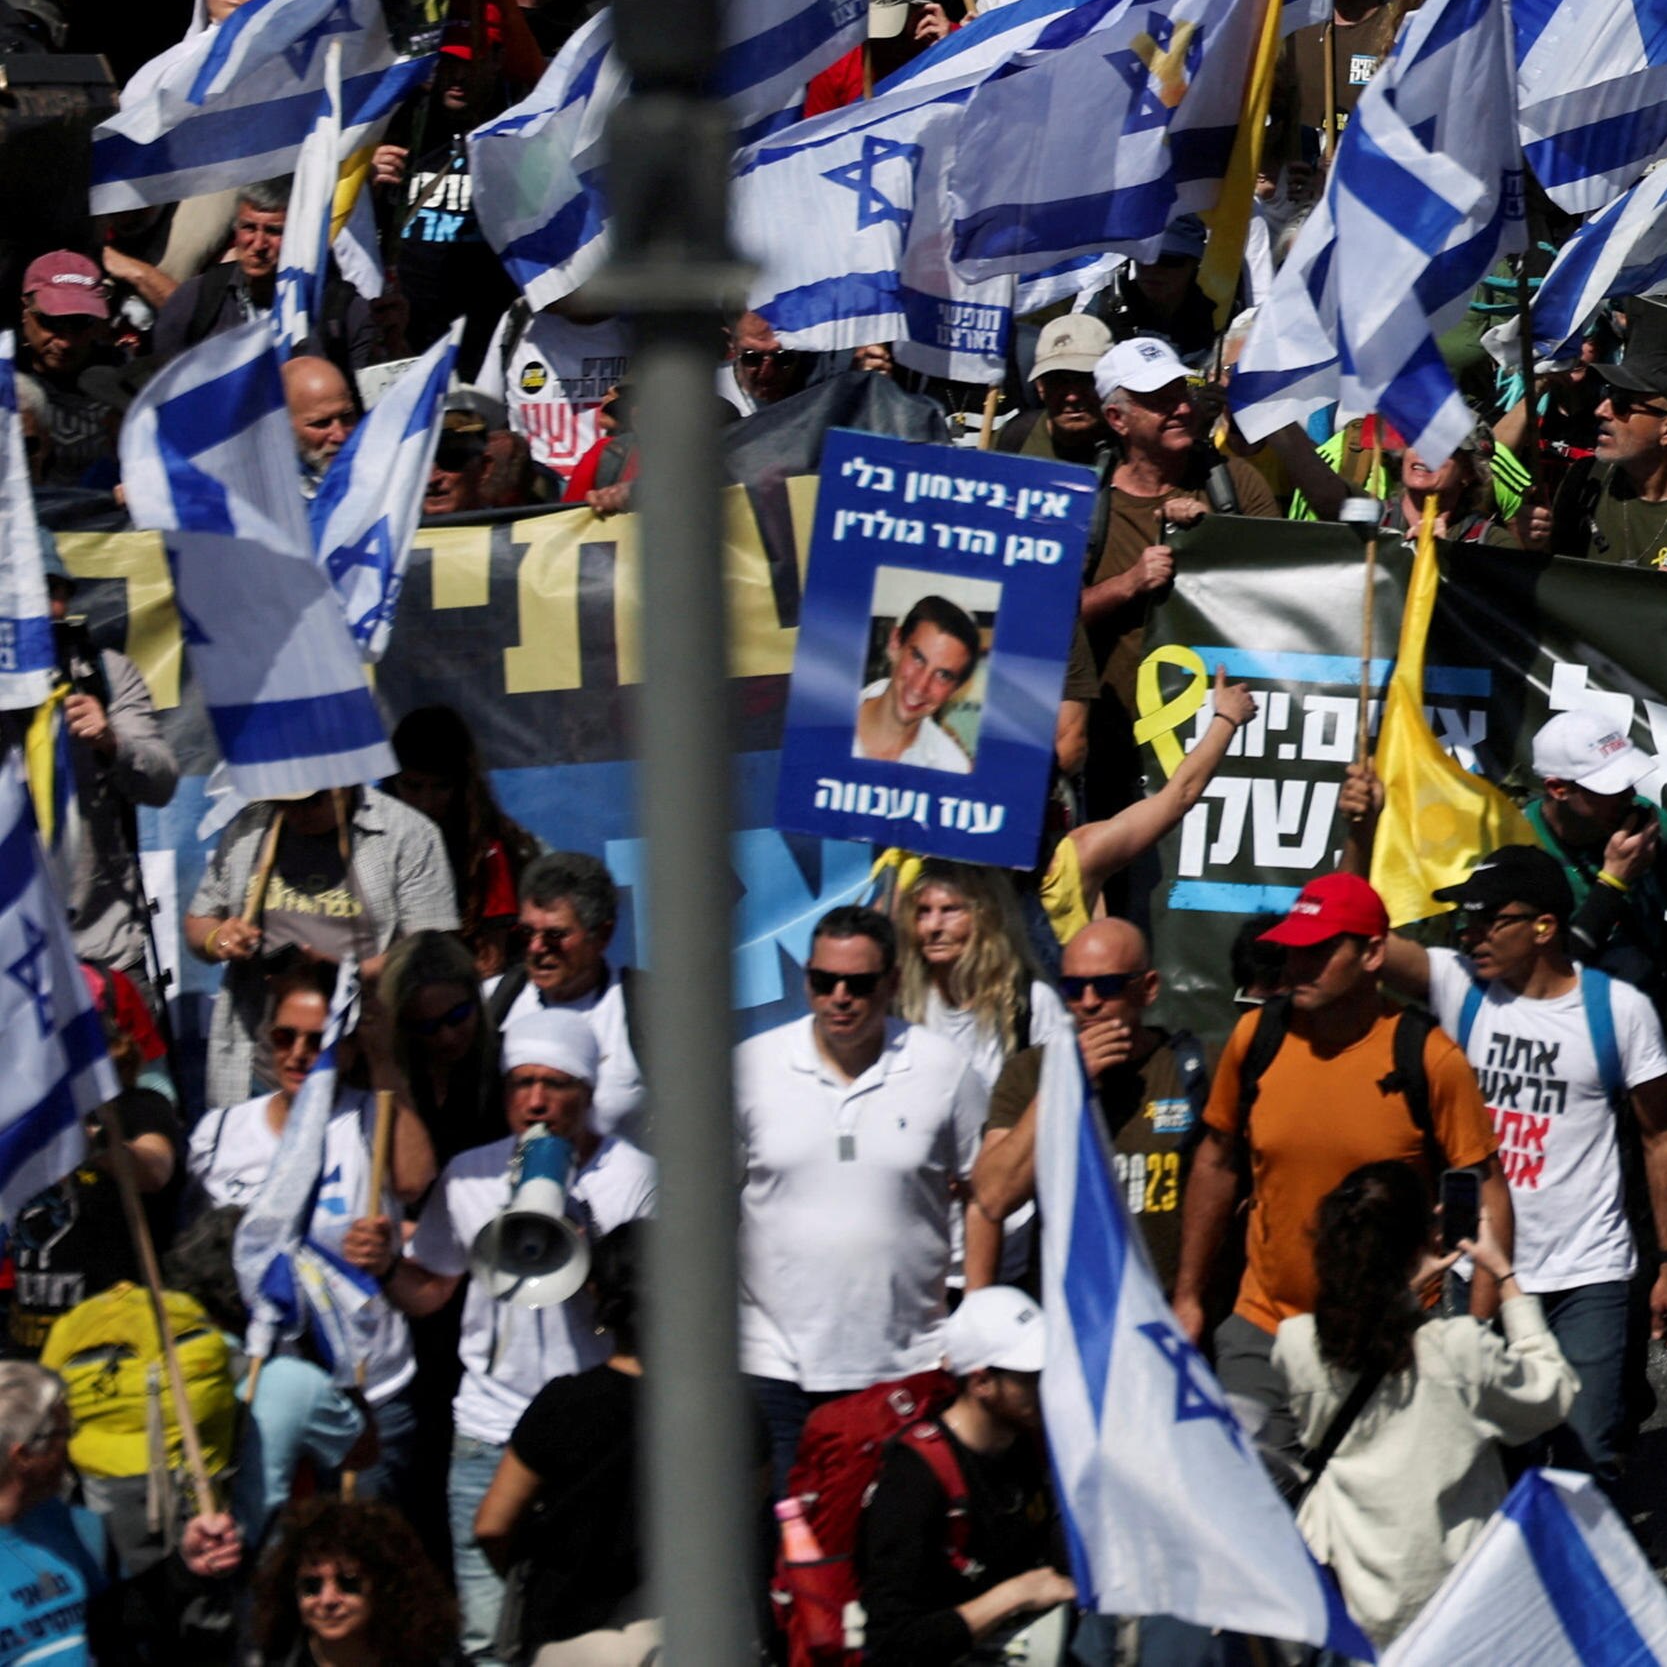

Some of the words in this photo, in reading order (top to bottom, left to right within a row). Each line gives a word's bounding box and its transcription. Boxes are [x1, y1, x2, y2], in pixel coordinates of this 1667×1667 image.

[841, 461, 896, 492] בלי
[905, 471, 1010, 509] ניצחון
[1014, 487, 1073, 519] אין
[834, 508, 927, 545] גולדין
[932, 520, 997, 556] הדר
[1003, 533, 1064, 567] סגן
[814, 775, 931, 827] וענווה
[937, 794, 1007, 835] עוז
[1486, 1031, 1561, 1074] אתה
[1476, 1068, 1569, 1116] הראש
[1487, 1108, 1552, 1152] את
[1501, 1147, 1545, 1191] אש
